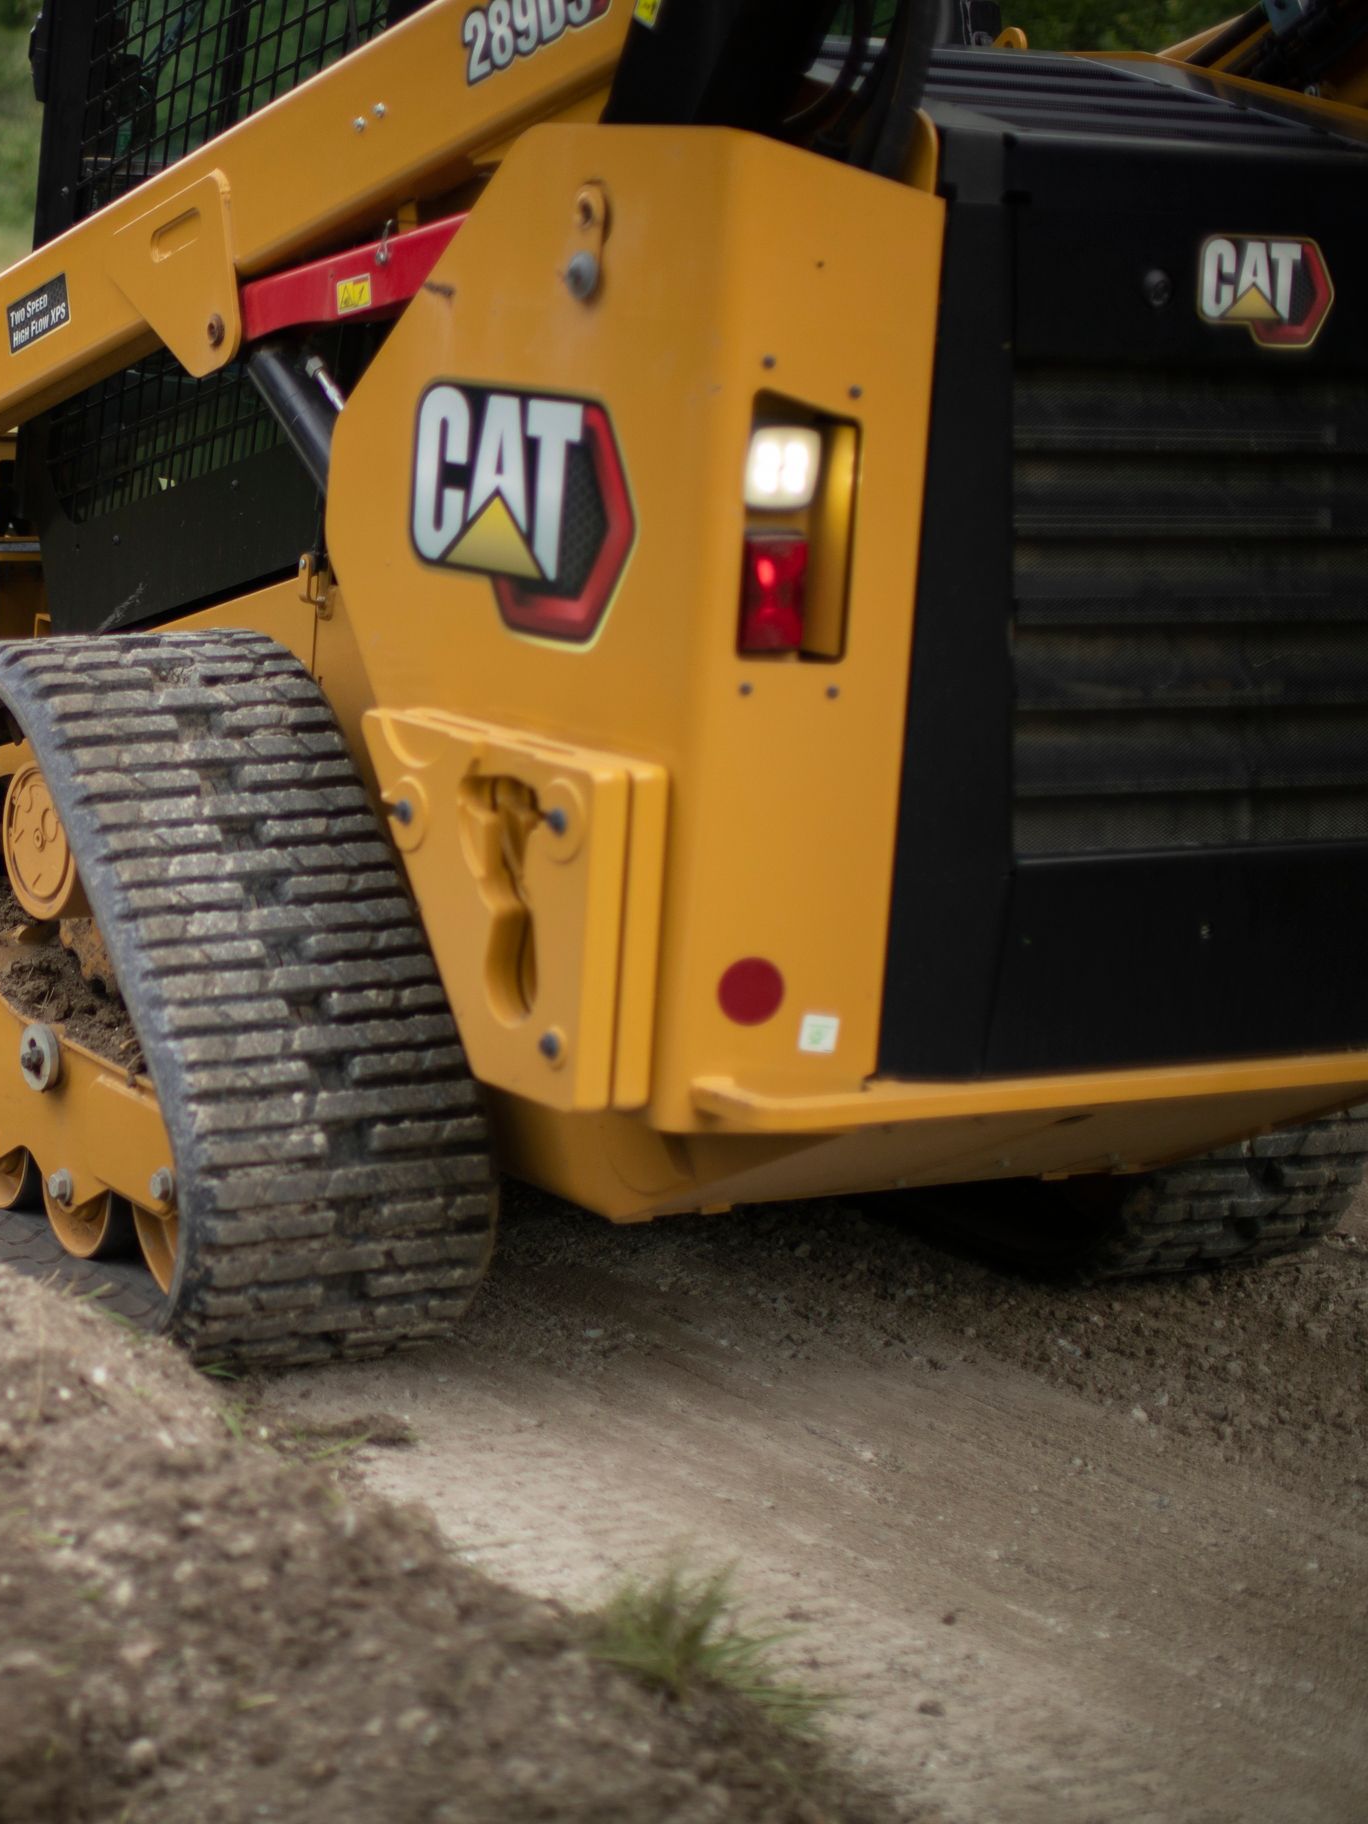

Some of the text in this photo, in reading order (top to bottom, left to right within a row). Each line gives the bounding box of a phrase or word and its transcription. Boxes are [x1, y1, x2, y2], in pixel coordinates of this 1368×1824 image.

[10, 293, 48, 327] TWO SPEED
[1201, 237, 1303, 325] CAT
[13, 301, 66, 348] HIGH FLOW XPS
[412, 385, 584, 582] CAT
